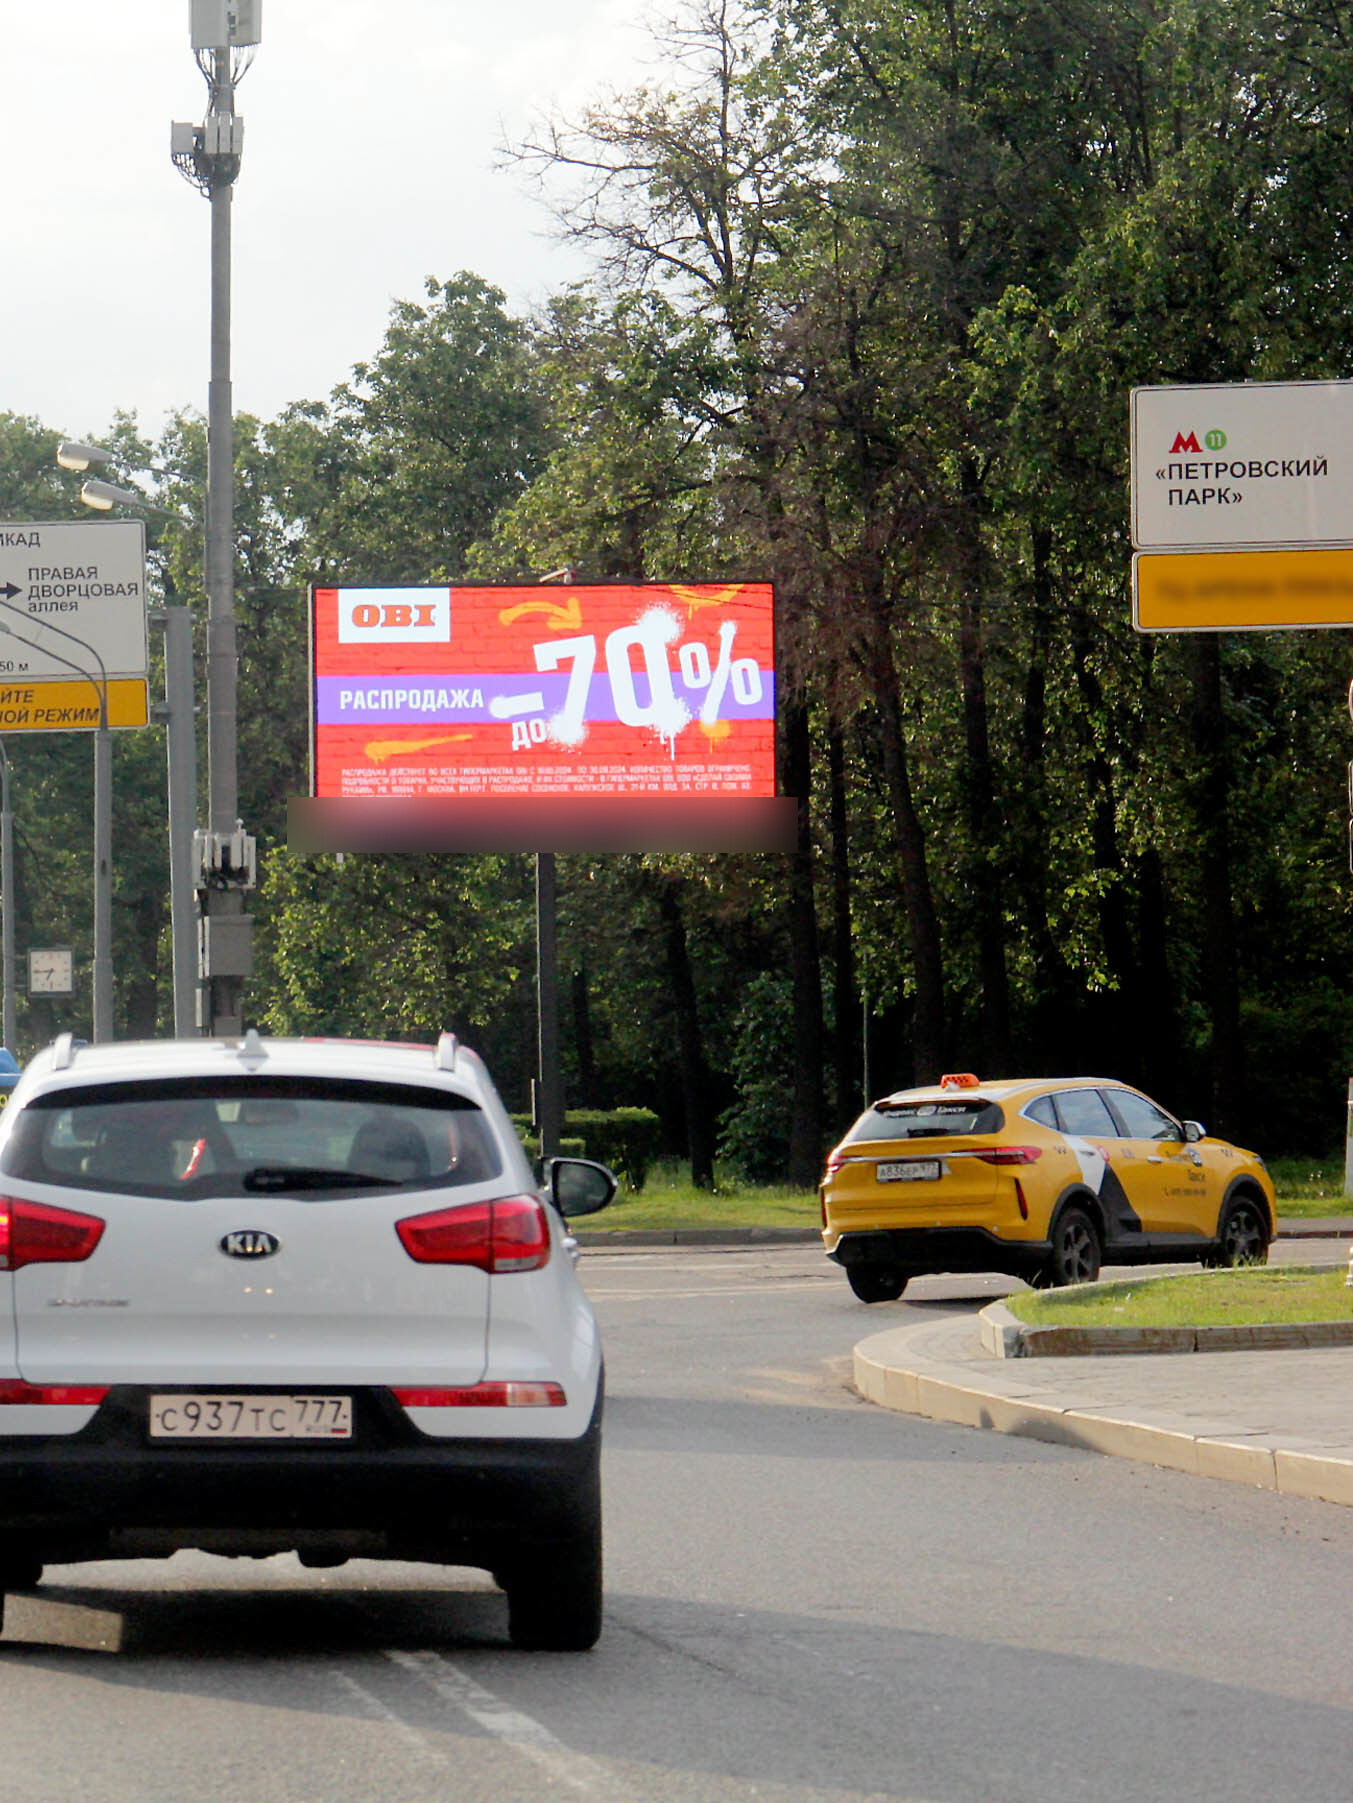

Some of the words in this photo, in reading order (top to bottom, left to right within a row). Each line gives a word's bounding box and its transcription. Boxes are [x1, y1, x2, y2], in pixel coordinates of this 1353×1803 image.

[1155, 455, 1328, 480] «ПЕТРОВСКИЙ
[1169, 488, 1243, 505] ПАРК»
[28, 566, 98, 581] ПРАВАЯ
[28, 583, 138, 600] ДВОРЦОВАЯ
[28, 602, 78, 612] аллея
[352, 604, 437, 628] OBI
[19, 663, 29, 671] м
[339, 688, 485, 711] РАСПРОДАЖА
[34, 708, 99, 722] РЕЖИМ
[226, 1233, 272, 1253] KIA
[160, 1401, 287, 1432] С937ТС
[295, 1400, 343, 1423] 777
